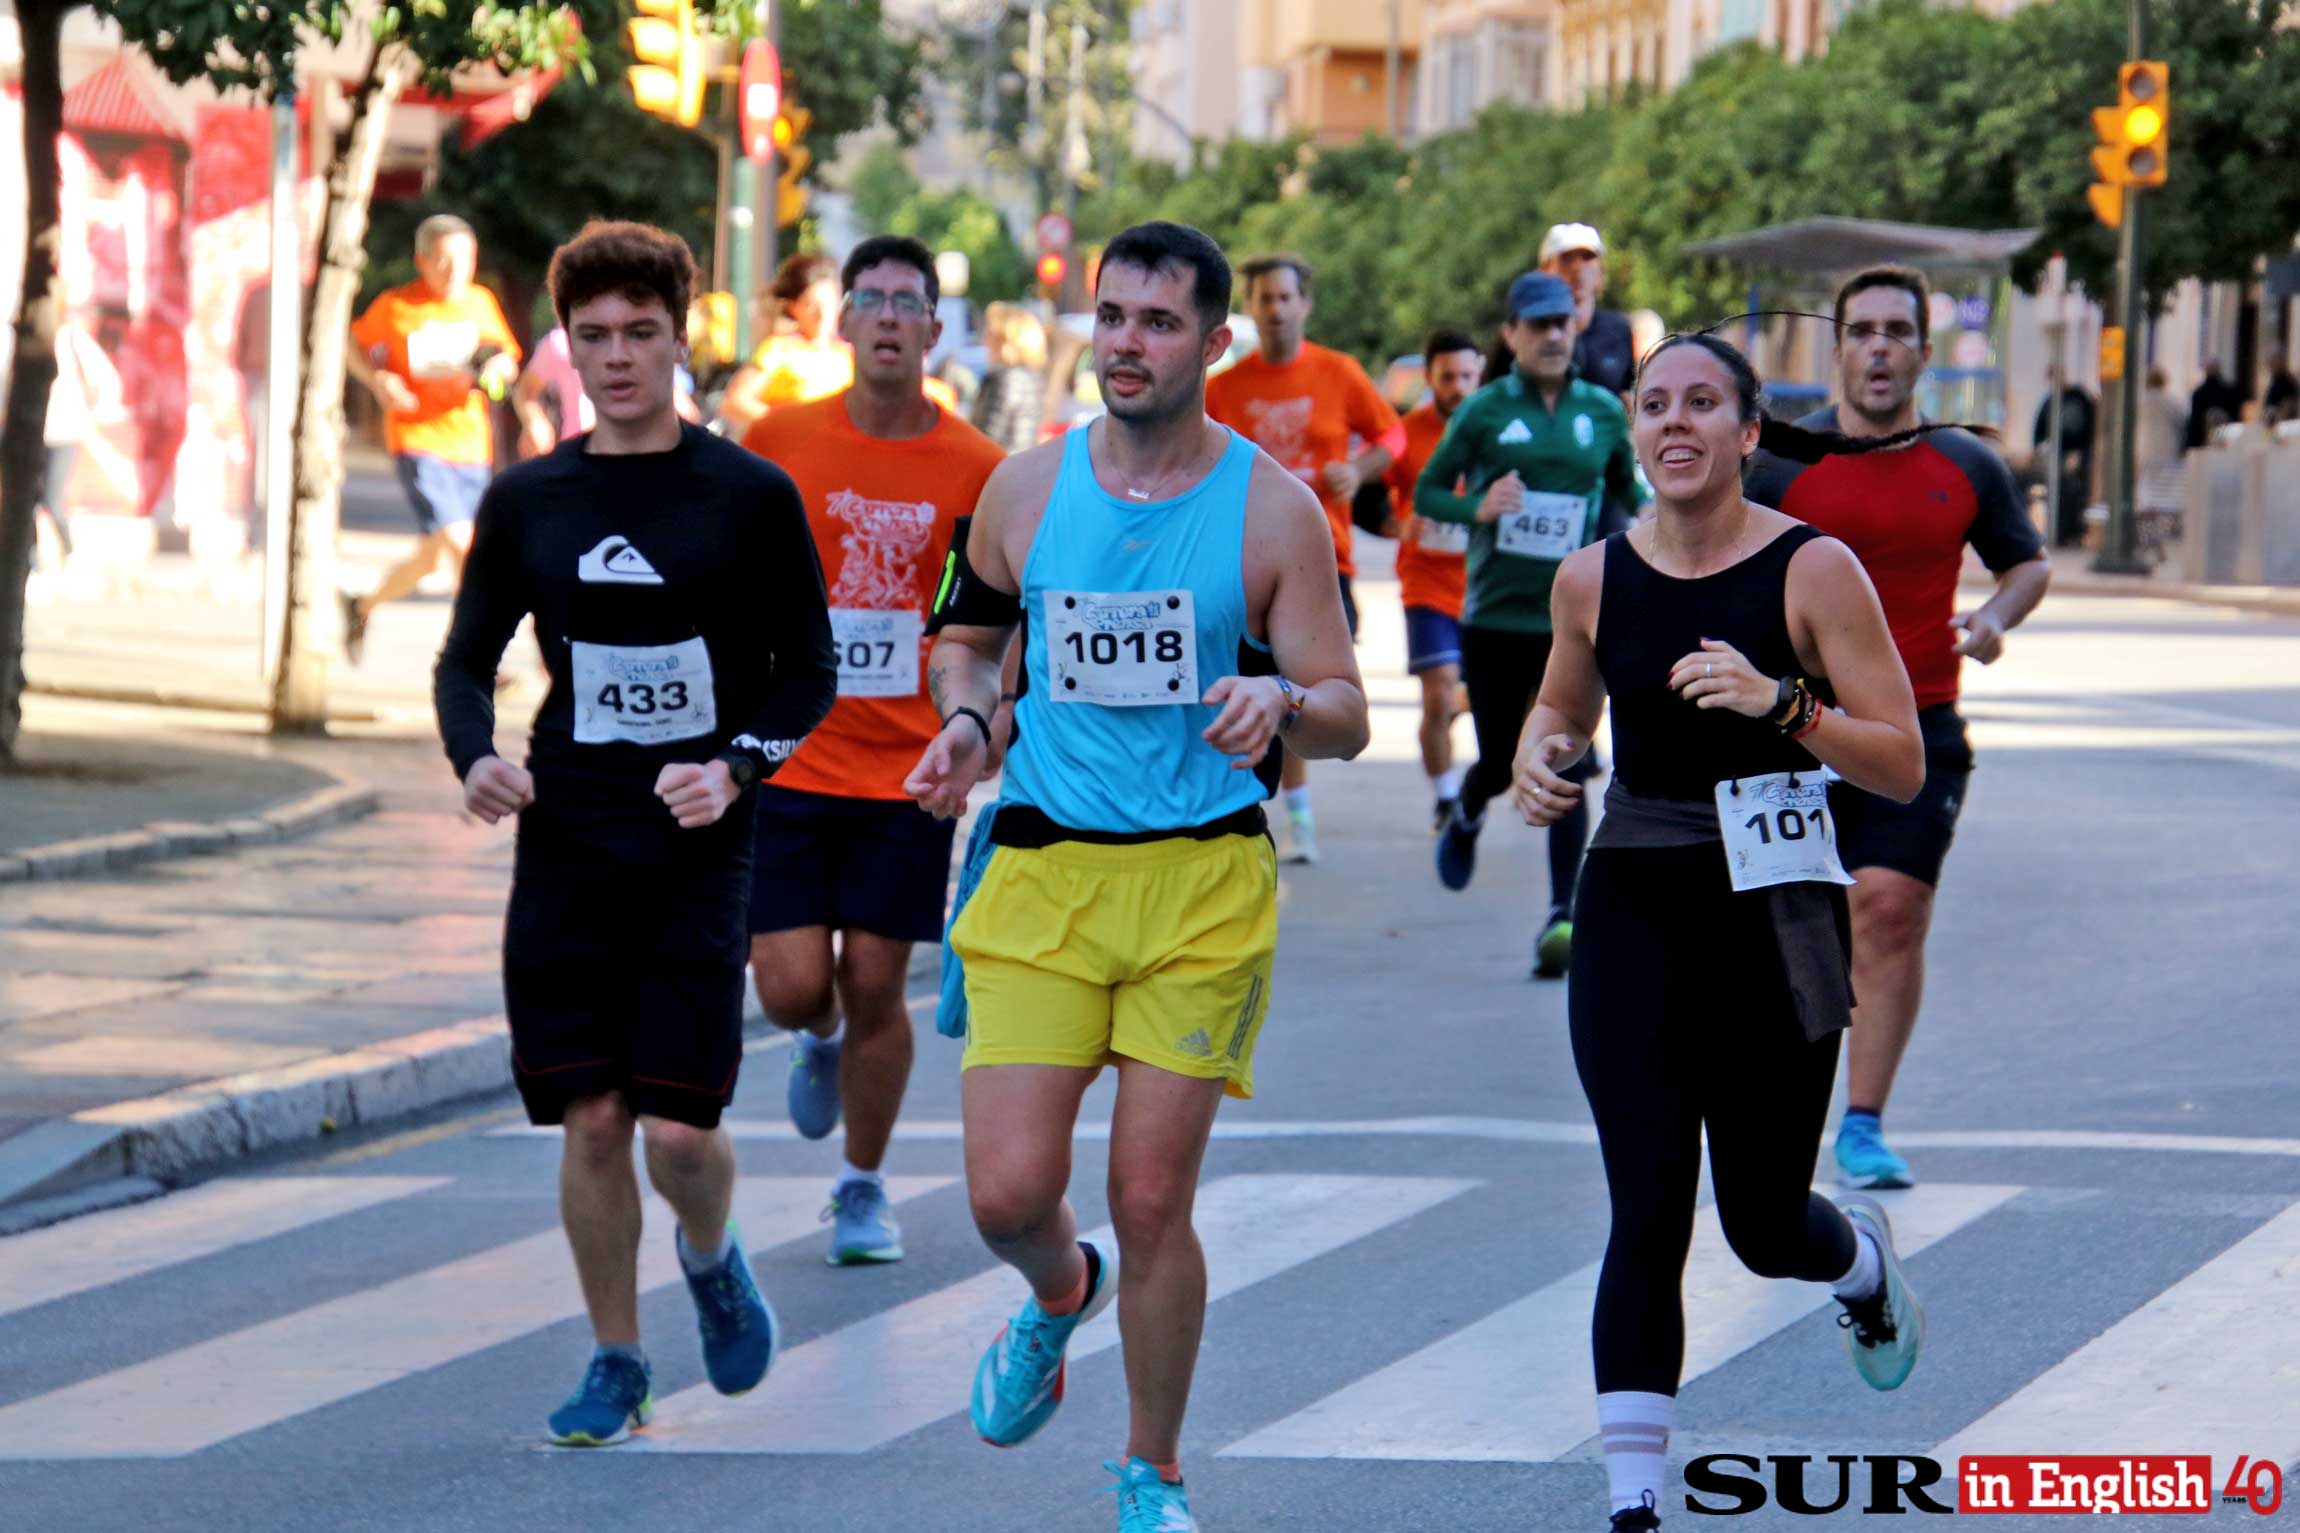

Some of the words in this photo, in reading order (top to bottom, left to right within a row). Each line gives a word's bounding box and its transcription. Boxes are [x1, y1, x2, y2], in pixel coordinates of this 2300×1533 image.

[1514, 515, 1569, 536] 463
[1065, 630, 1183, 664] 1018
[597, 681, 688, 714] 433
